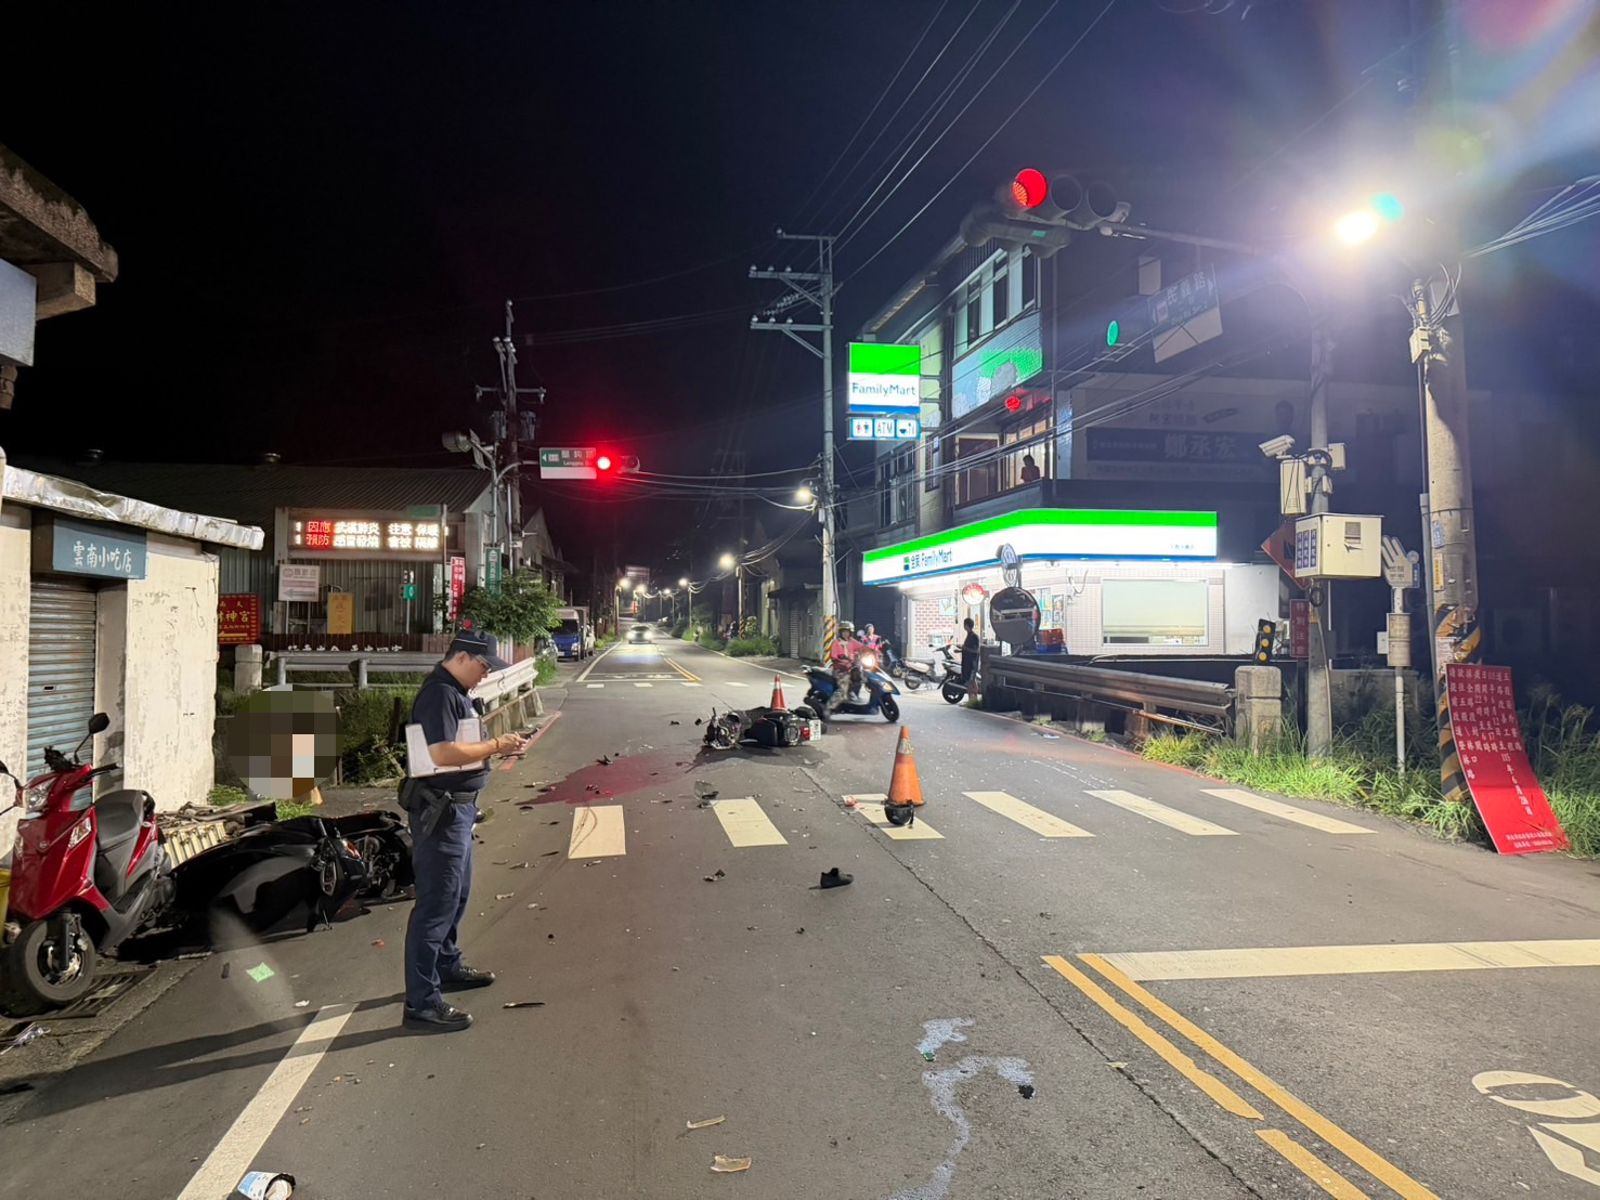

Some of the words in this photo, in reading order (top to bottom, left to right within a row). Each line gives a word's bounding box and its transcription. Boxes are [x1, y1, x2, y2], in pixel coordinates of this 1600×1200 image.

[851, 382, 917, 398] FamilyMart
[876, 421, 893, 435] ATM
[72, 540, 132, 573] 雲南小吃店
[921, 547, 953, 568] FamilyMart
